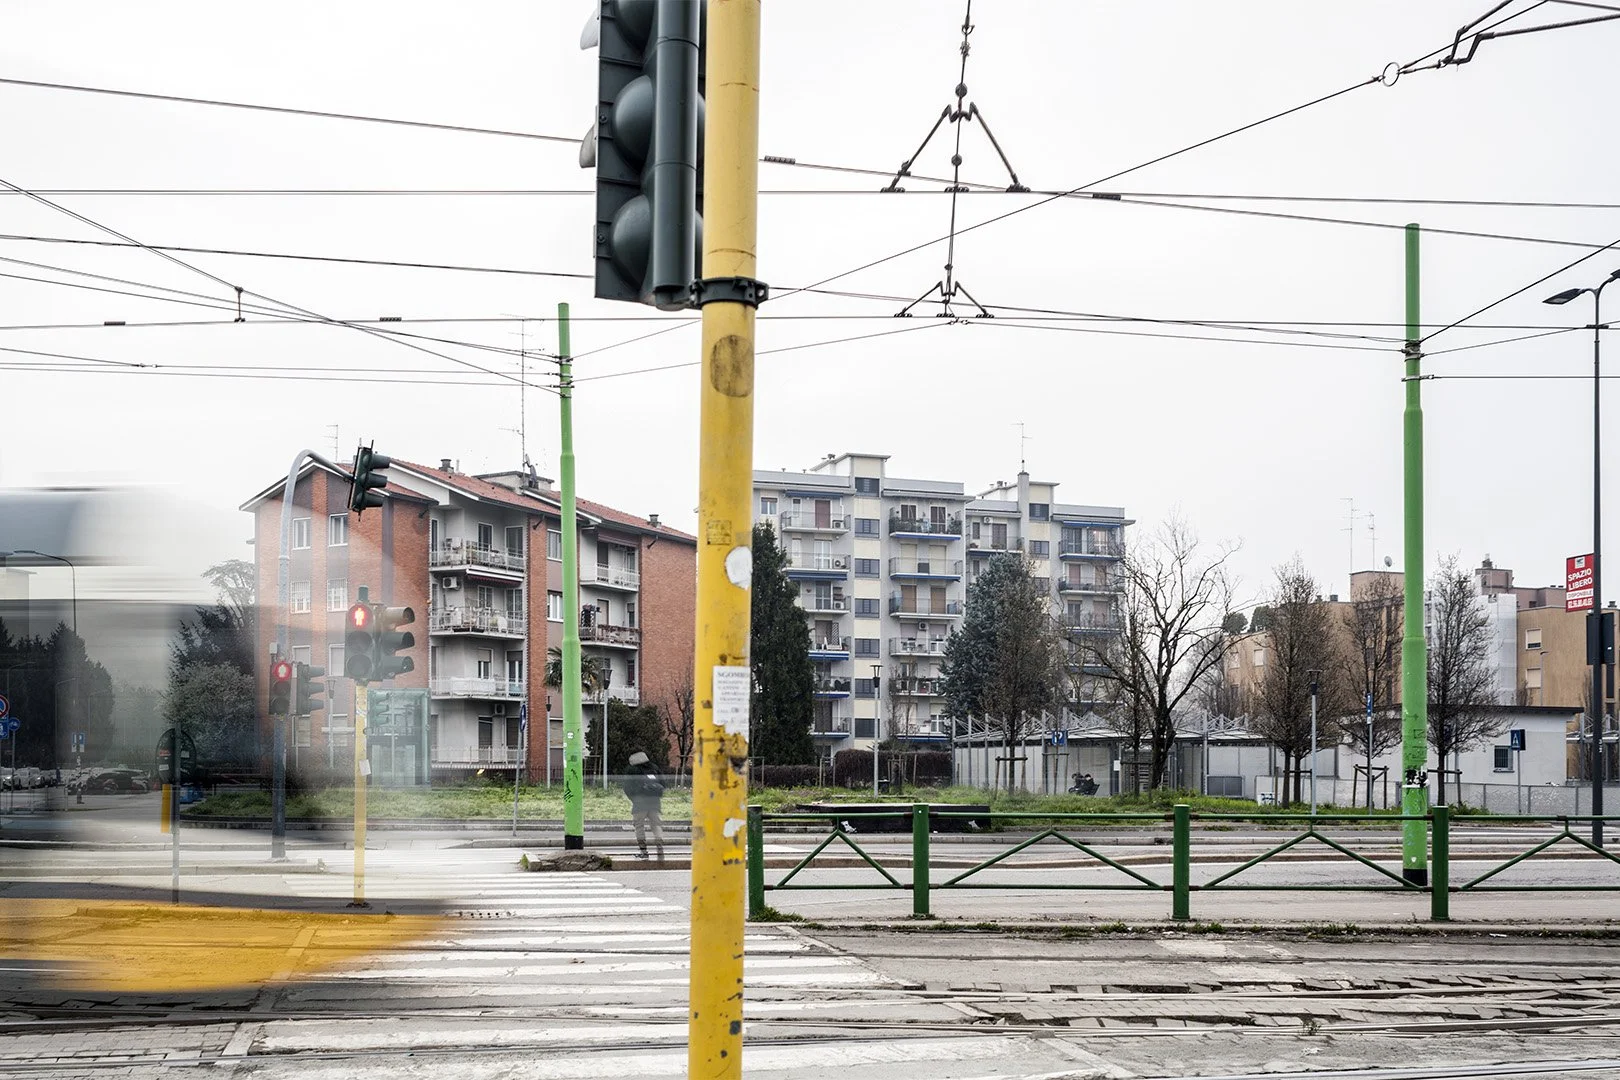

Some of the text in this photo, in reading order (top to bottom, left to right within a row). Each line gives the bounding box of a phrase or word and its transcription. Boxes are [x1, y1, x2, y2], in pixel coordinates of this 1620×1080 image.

[1568, 568, 1592, 582] SPAZIO
[1568, 577, 1593, 591] LIBERO
[1567, 590, 1592, 599] DISPONIBILE
